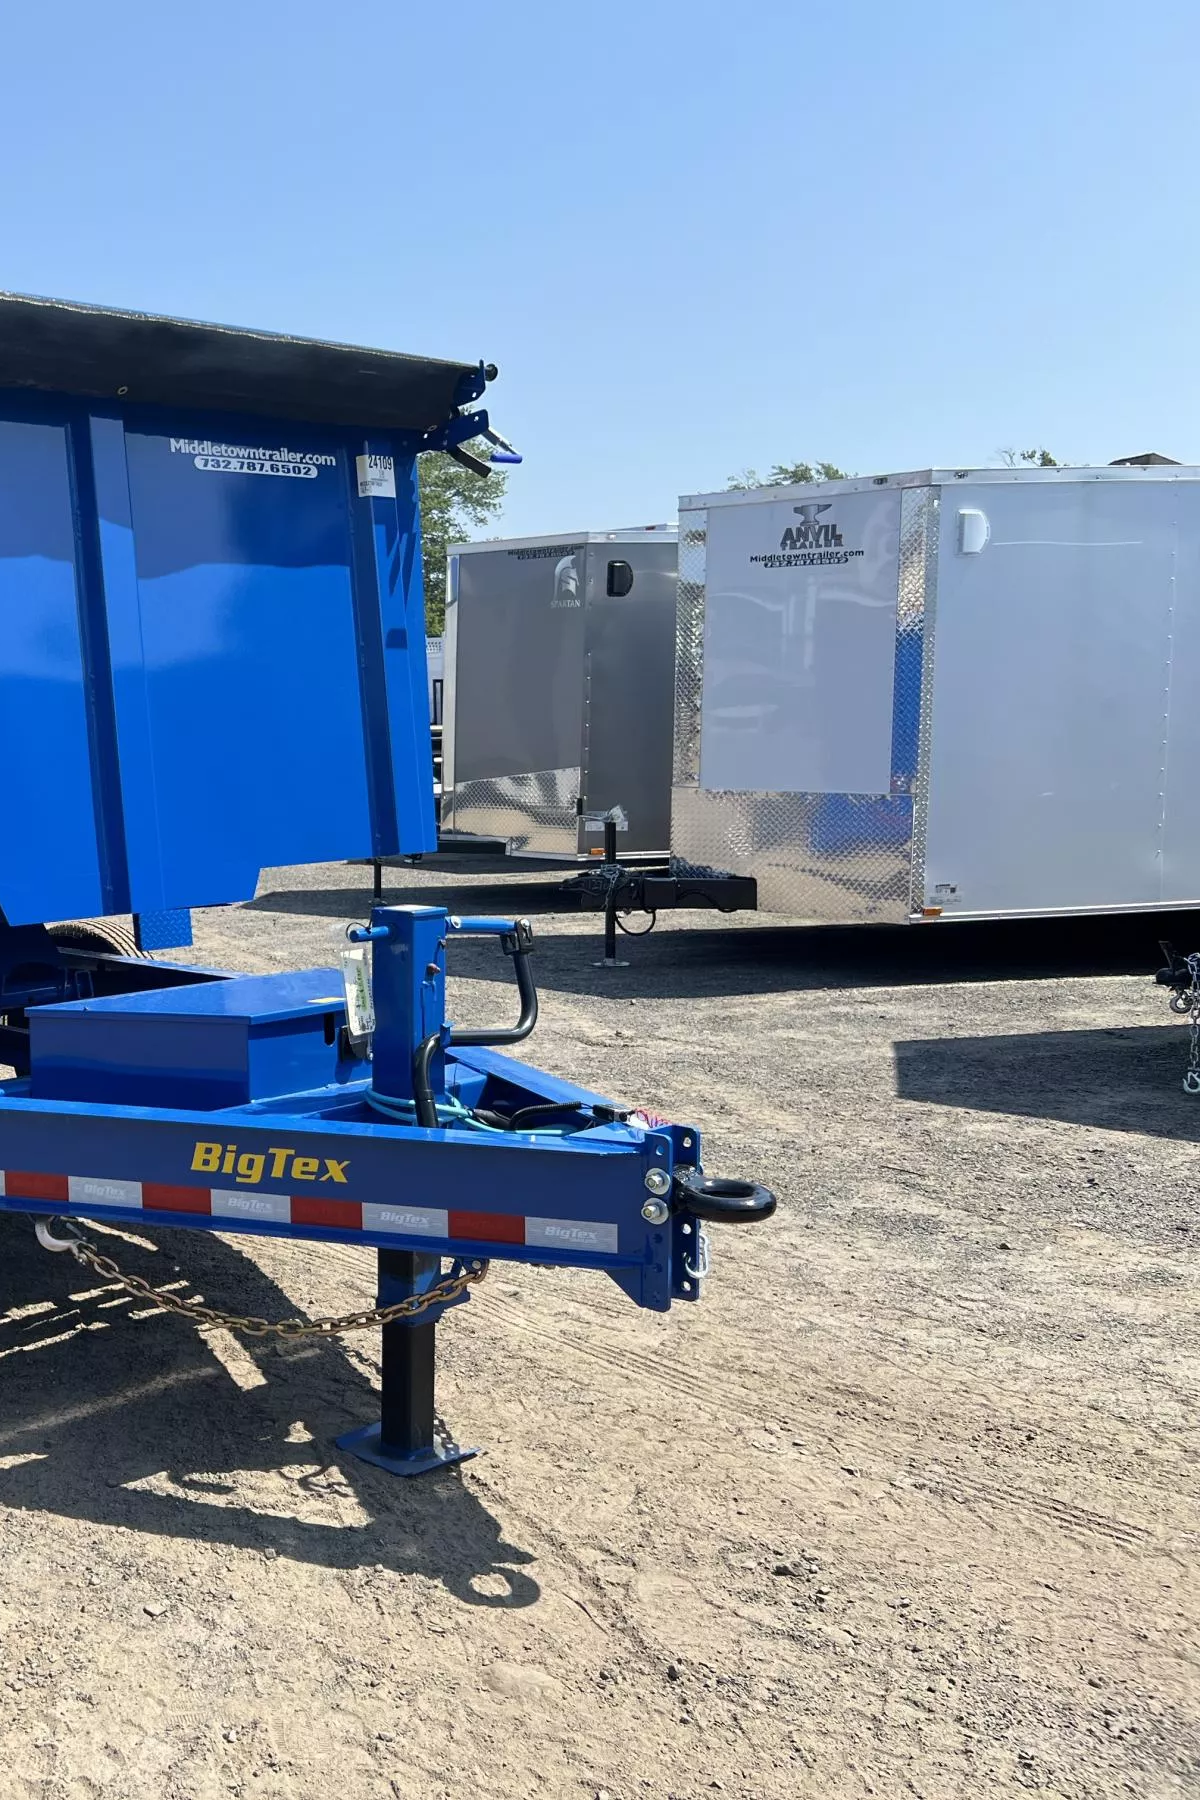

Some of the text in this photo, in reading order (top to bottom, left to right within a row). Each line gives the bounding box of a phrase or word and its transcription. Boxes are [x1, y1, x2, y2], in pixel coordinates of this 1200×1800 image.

[170, 438, 336, 466] Middletowntrailer.com
[200, 458, 313, 476] 732.787.6502
[780, 524, 843, 545] ANVIL
[750, 550, 864, 563] Middletowntrailer.com
[550, 599, 581, 609] SPARTAN
[190, 1141, 351, 1184] BigTex
[228, 1197, 273, 1211] BigTex
[379, 1211, 432, 1225] BigTex
[543, 1226, 598, 1240] BigTex
